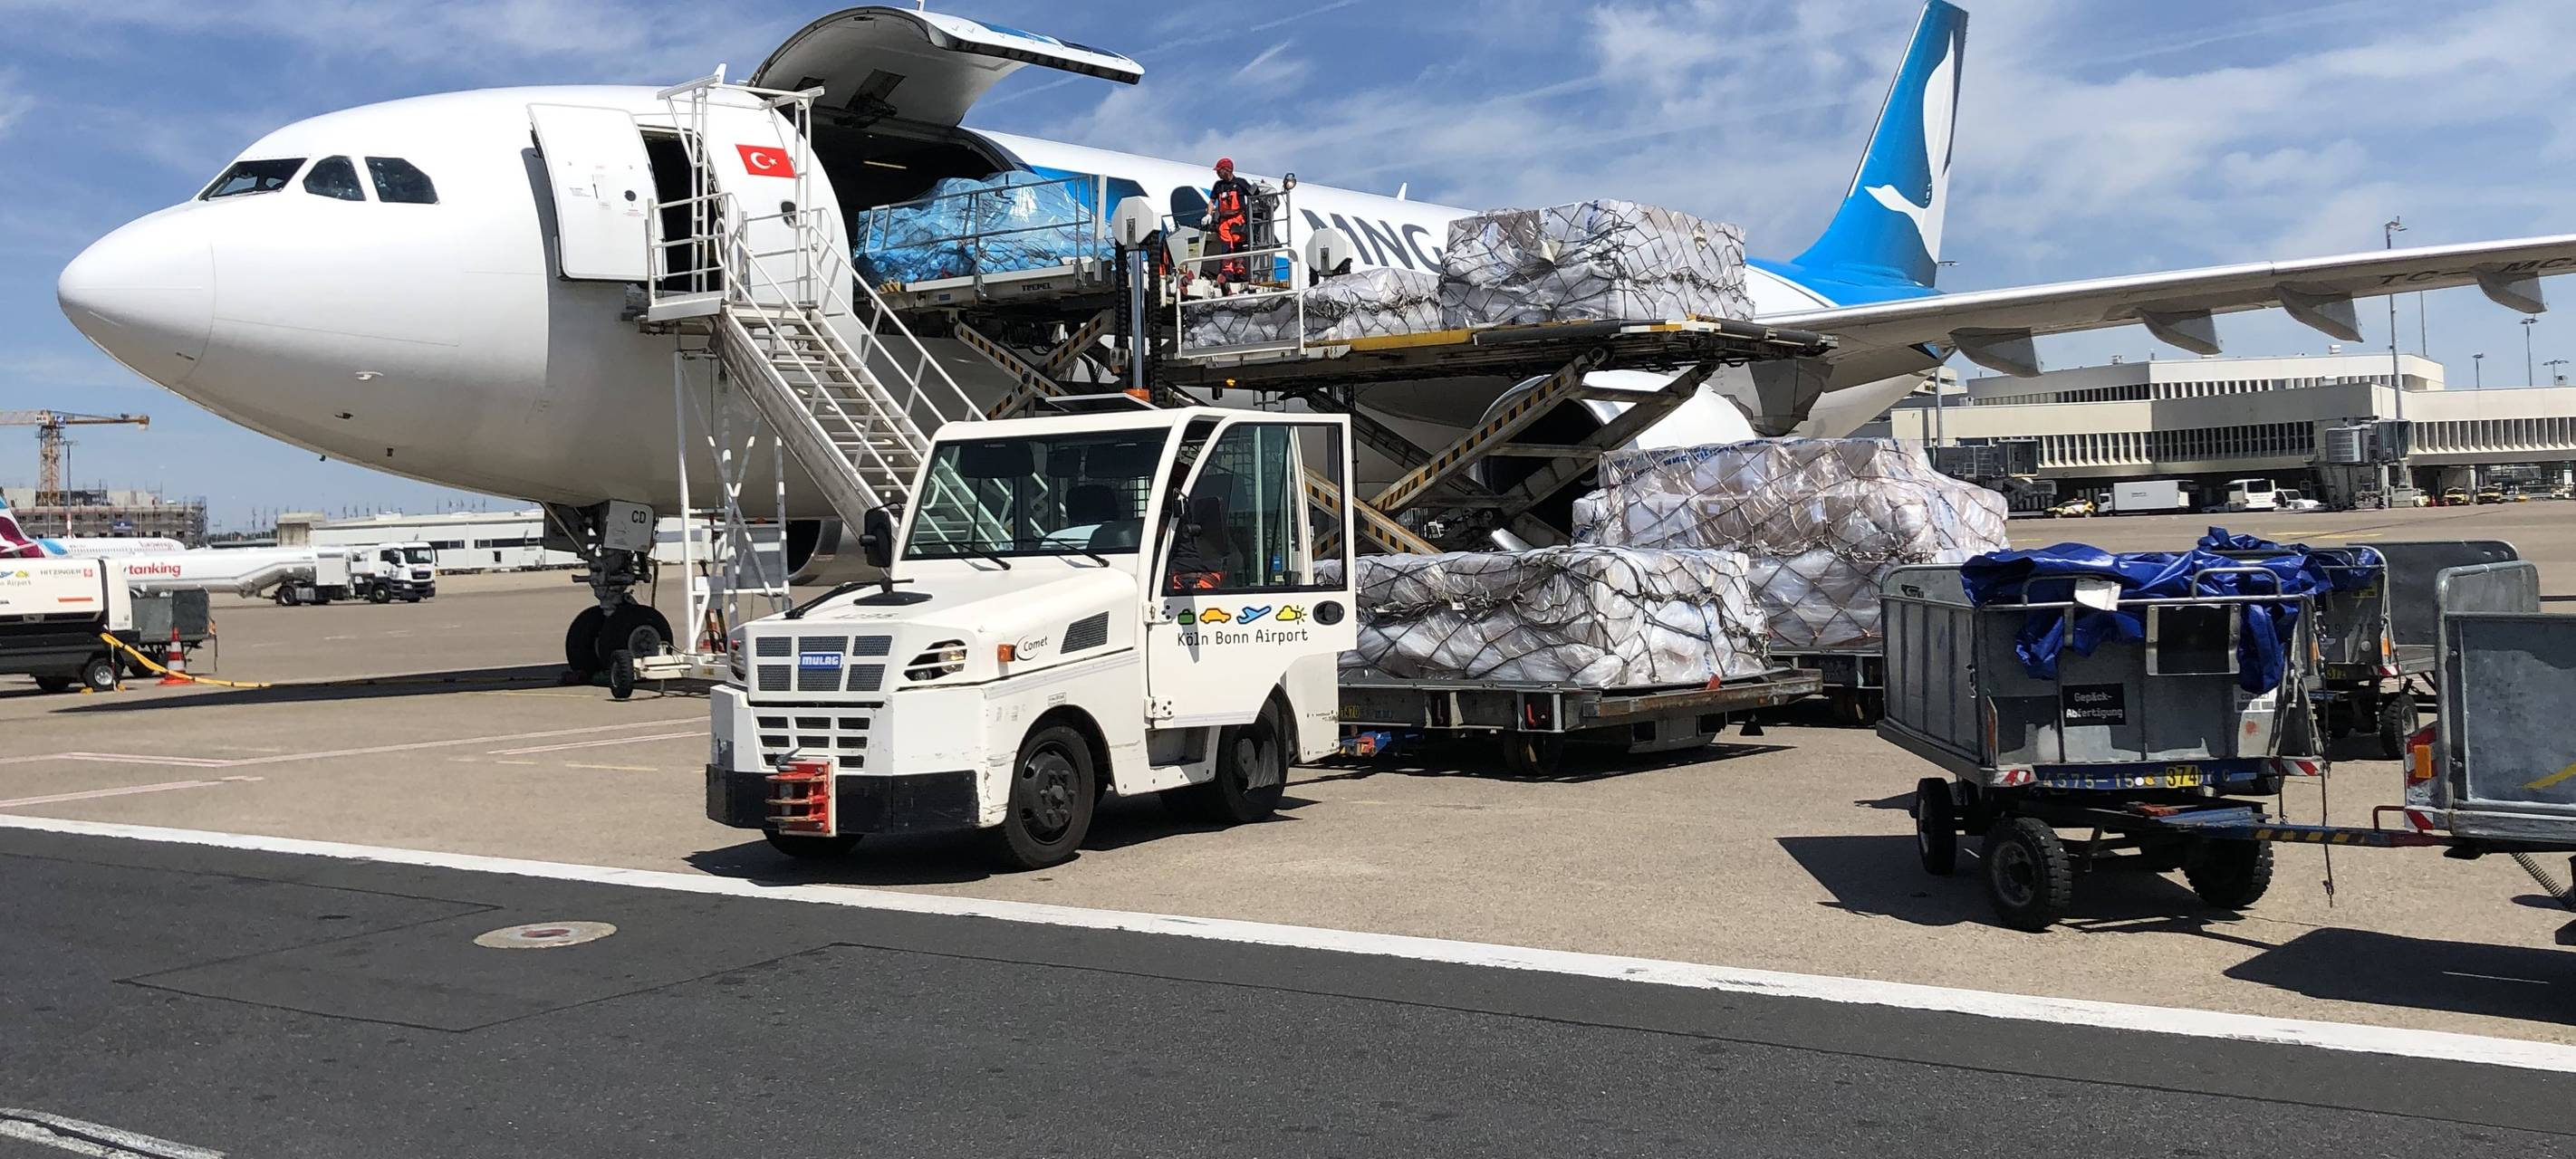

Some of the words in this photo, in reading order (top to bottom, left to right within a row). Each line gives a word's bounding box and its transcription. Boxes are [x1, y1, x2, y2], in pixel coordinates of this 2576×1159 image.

[2379, 257, 2576, 285] TC-MC
[631, 511, 647, 523] CD
[123, 562, 181, 577] tanking
[1024, 636, 1048, 651] Comet
[1177, 632, 1208, 647] Köln
[1216, 630, 1248, 645] Bonn
[1255, 628, 1309, 646] Airport
[802, 656, 839, 666] MULAG
[2066, 707, 2123, 719] Abfertigung
[2166, 766, 2197, 787] 374
